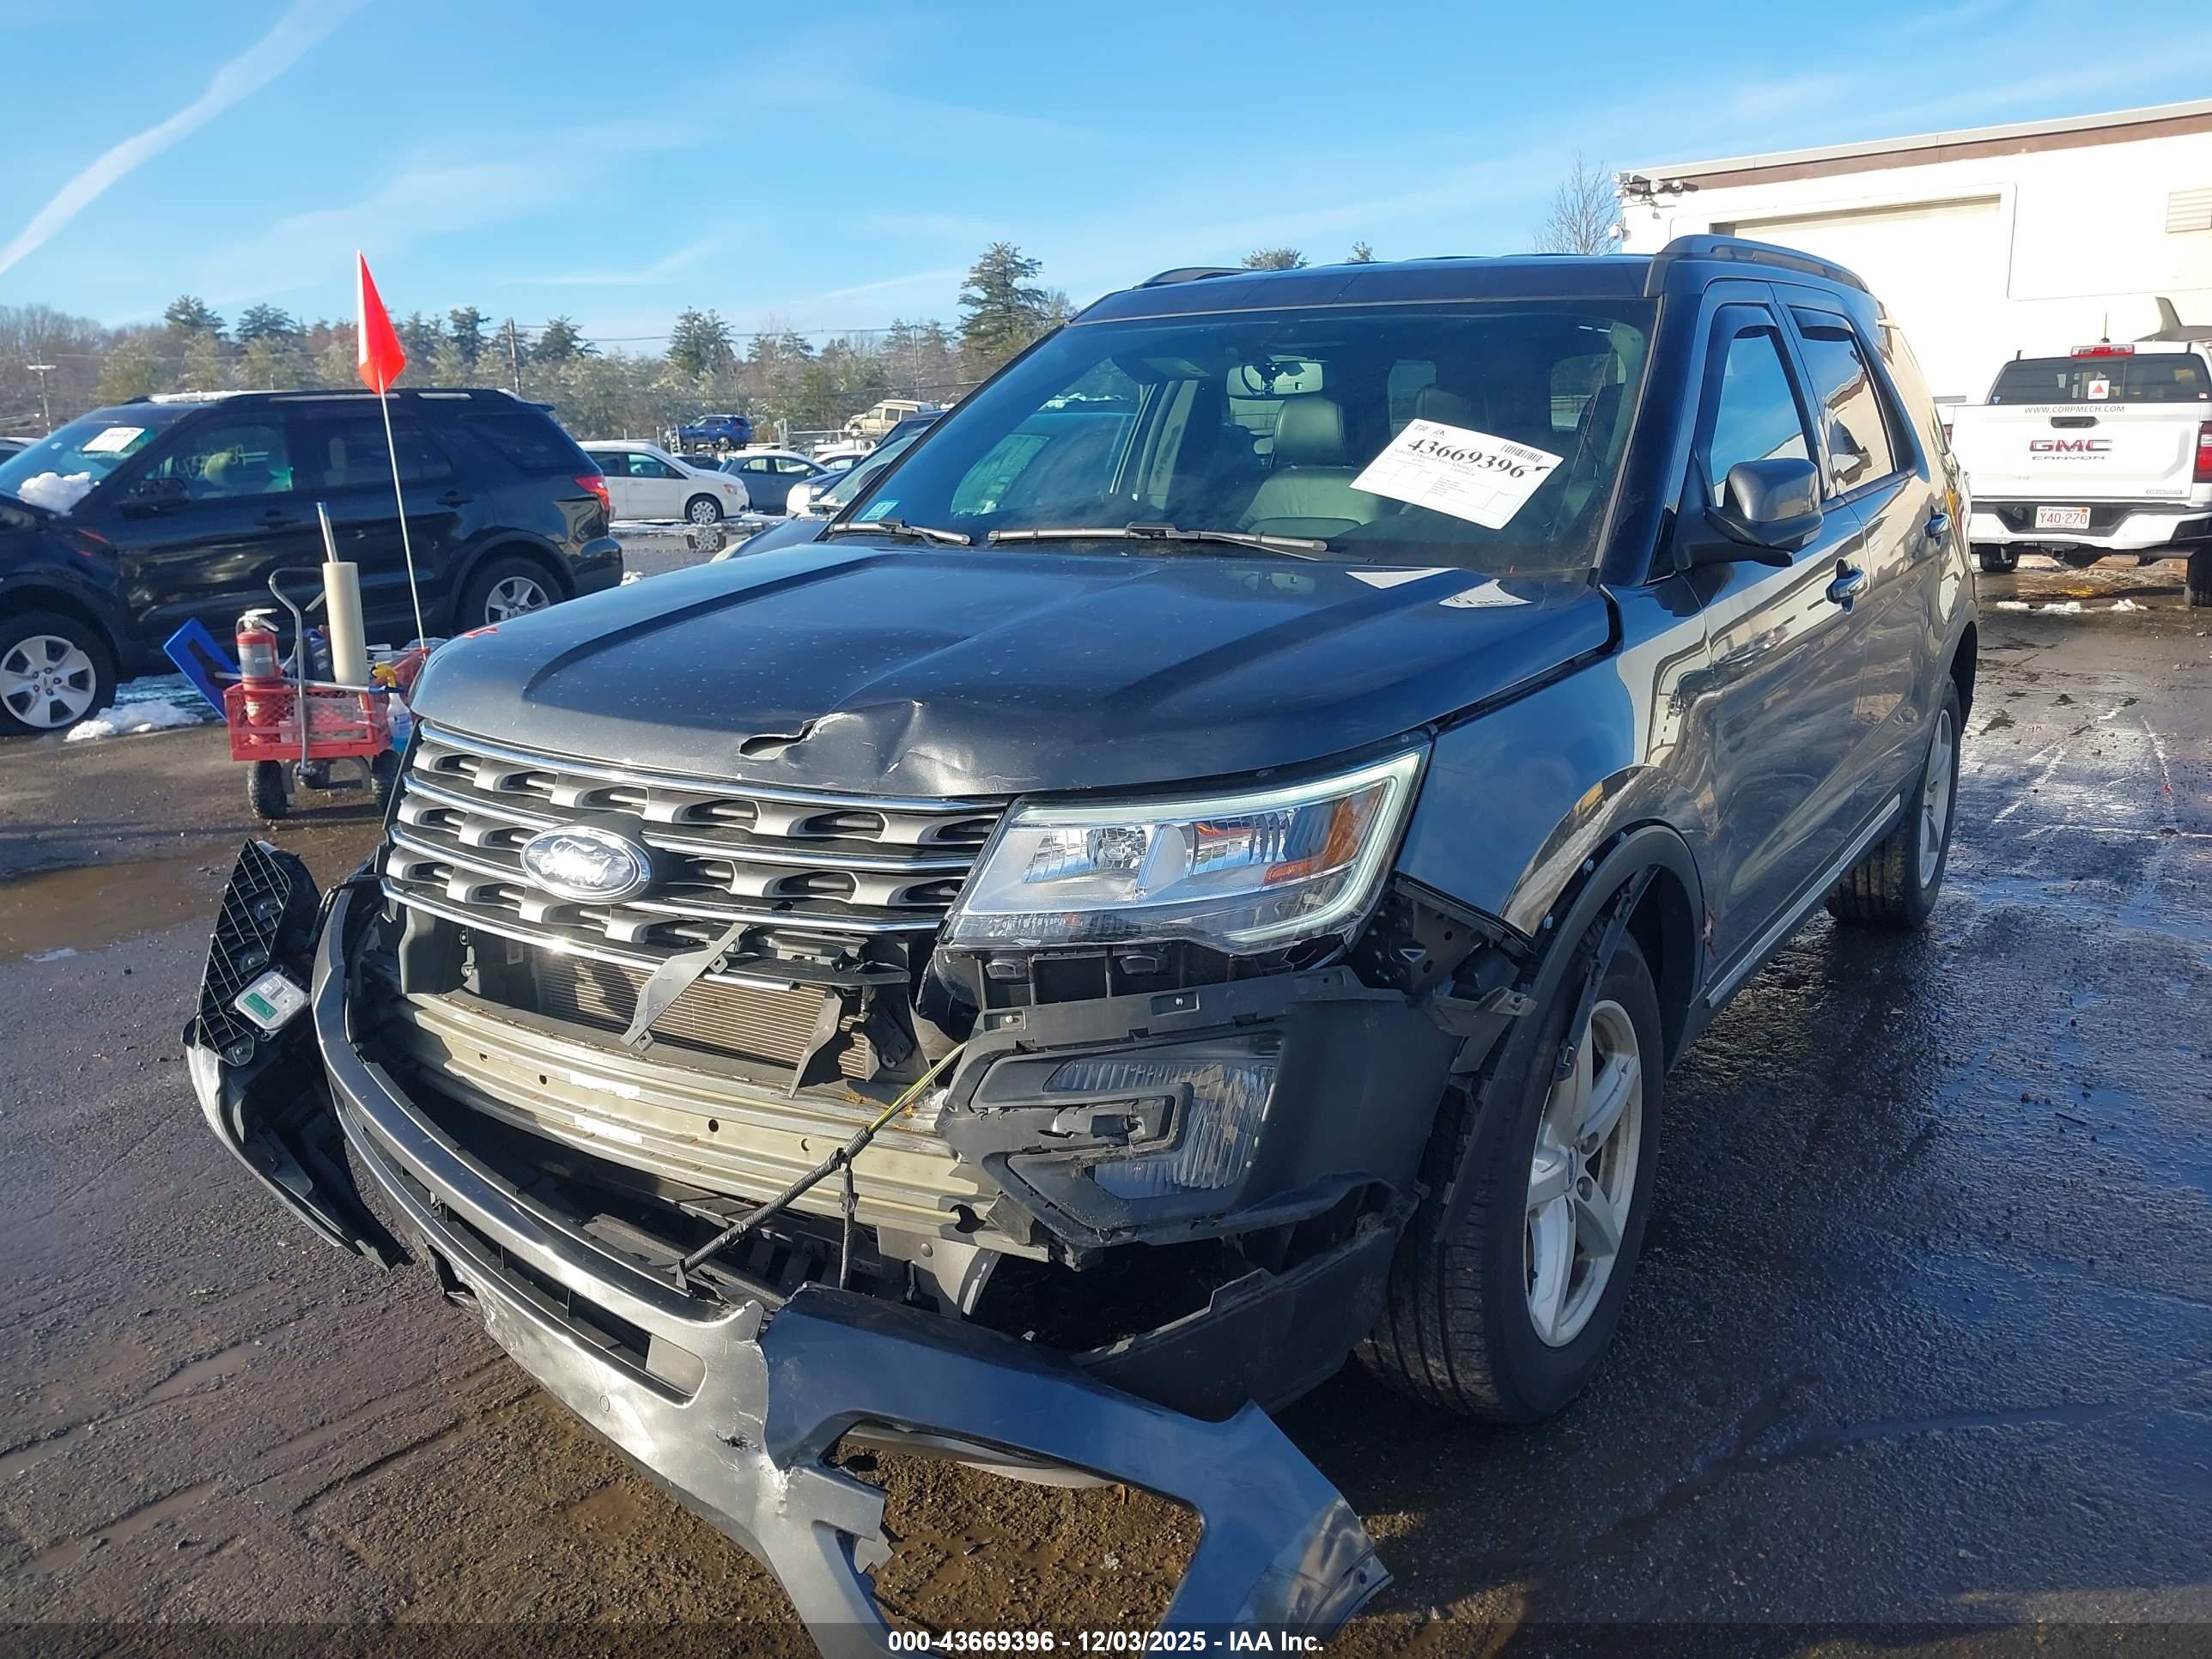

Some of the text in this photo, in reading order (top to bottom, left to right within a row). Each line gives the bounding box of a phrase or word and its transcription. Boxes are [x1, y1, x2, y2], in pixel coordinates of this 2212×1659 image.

[2024, 405, 2125, 414] WWW.CORPMECH.COM
[1407, 439, 1530, 478] 43669396
[2029, 439, 2113, 453] GMC
[538, 836, 614, 886] Fd
